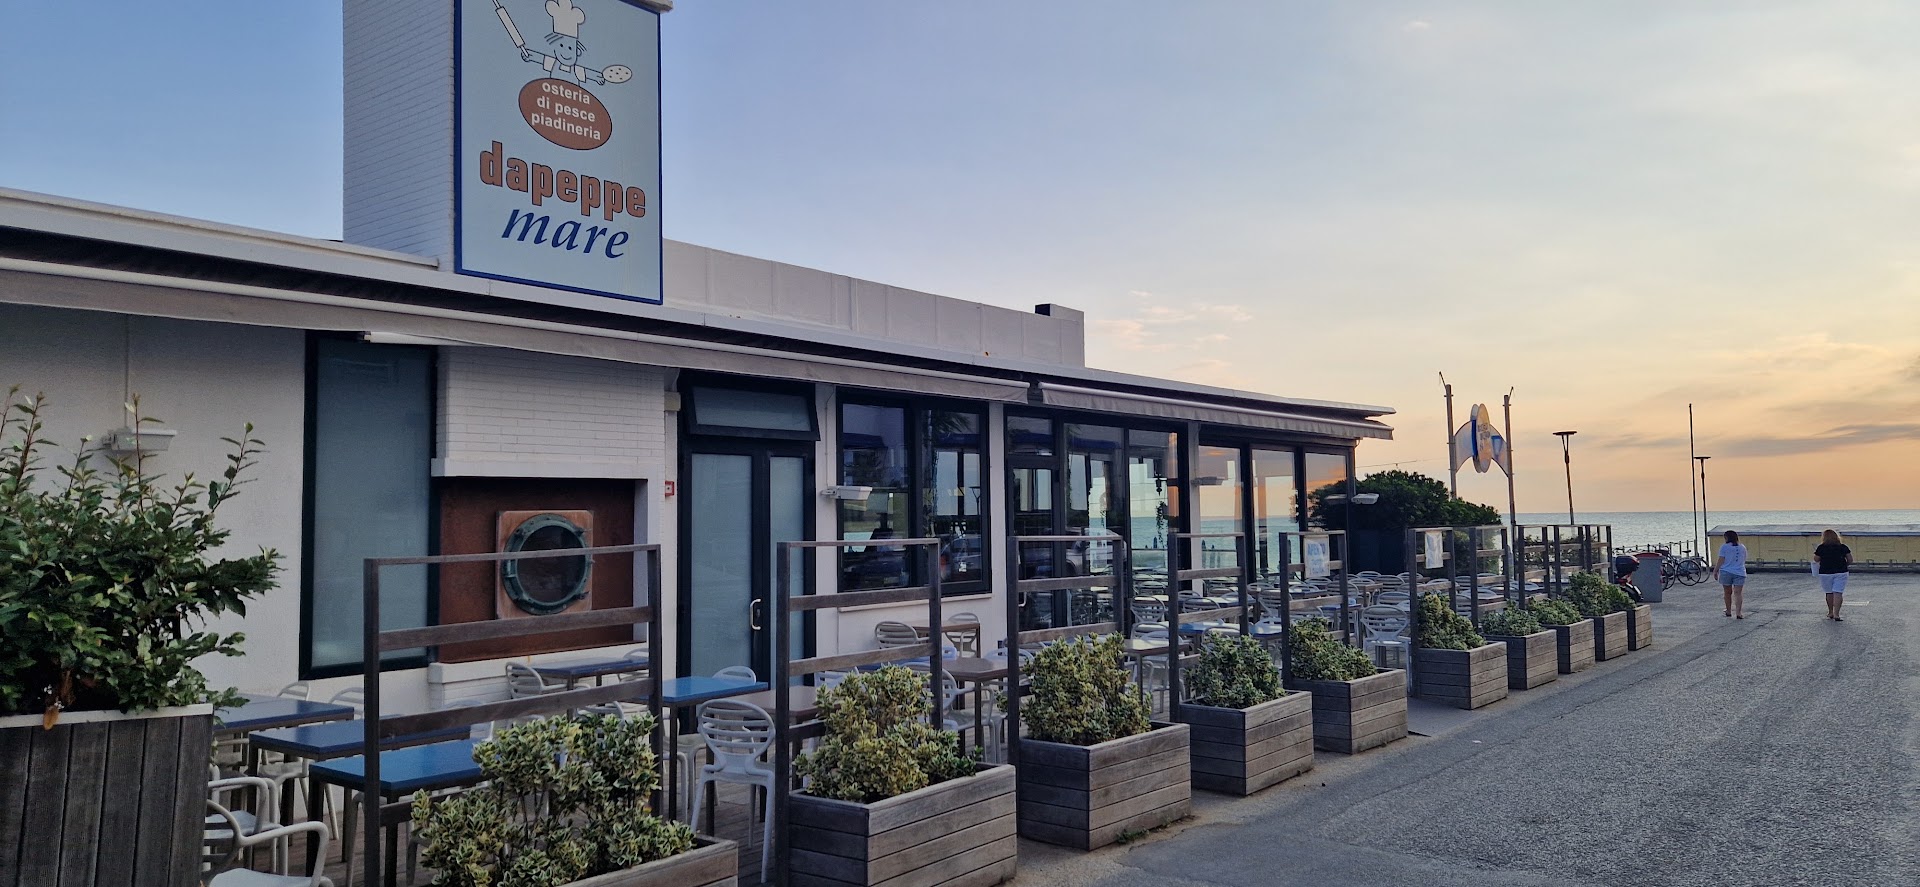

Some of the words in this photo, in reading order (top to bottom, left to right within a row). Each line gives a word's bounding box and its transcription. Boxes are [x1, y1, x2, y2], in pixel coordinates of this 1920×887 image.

[542, 82, 590, 105] osteria
[536, 95, 550, 110] di
[555, 102, 596, 122] pesce
[531, 112, 601, 141] piadineria
[479, 140, 646, 221] dapeppe
[501, 209, 629, 258] mare
